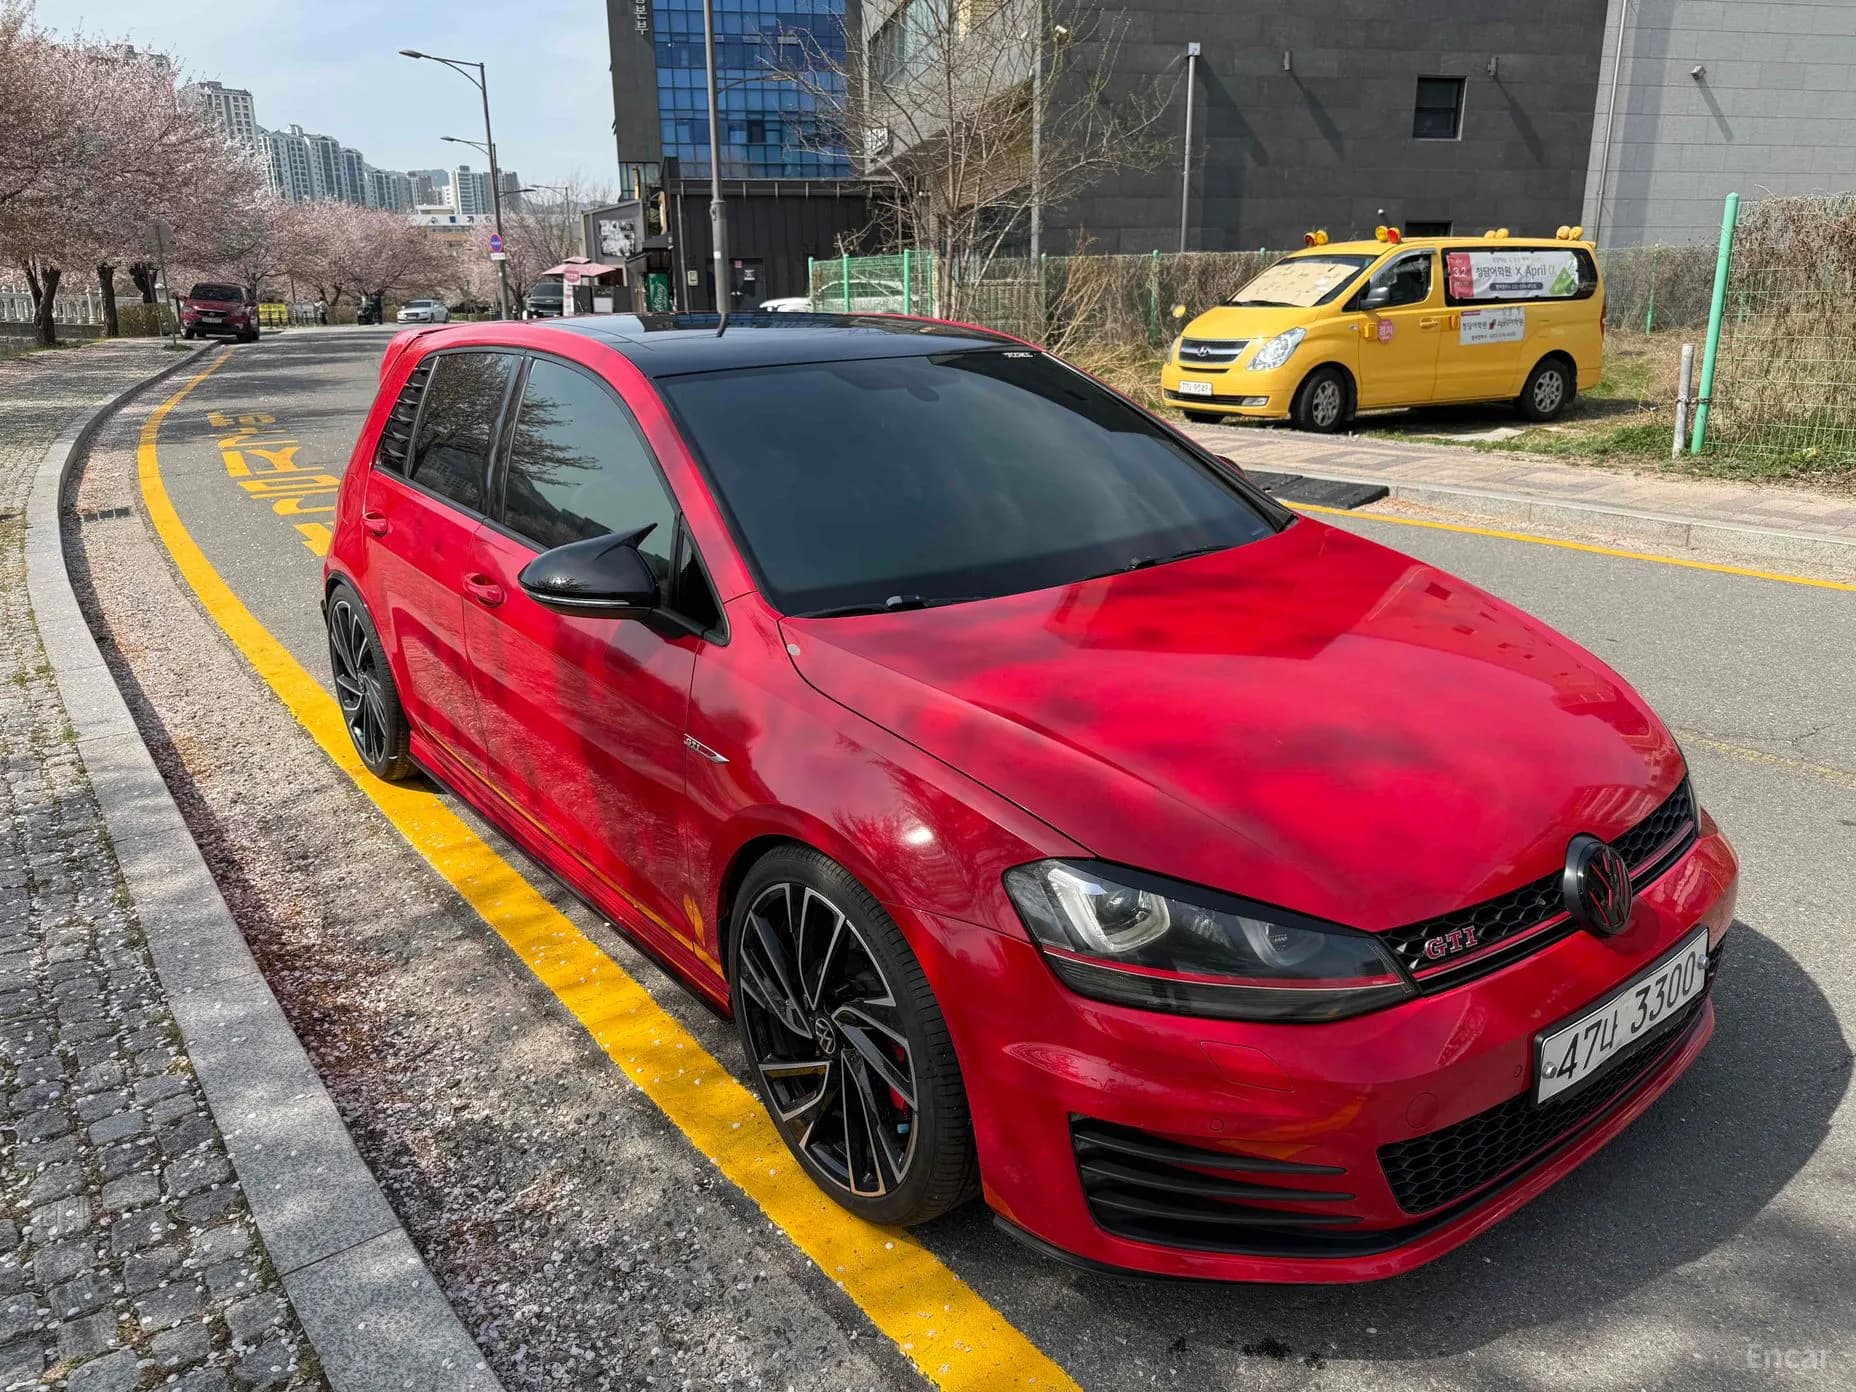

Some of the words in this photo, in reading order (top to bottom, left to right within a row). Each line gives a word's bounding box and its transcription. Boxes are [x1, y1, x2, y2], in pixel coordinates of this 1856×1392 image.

[1526, 264, 1547, 280] April
[1424, 925, 1478, 961] GTI
[1556, 1008, 1618, 1079] 47너
[1630, 950, 1697, 1034] 3300
